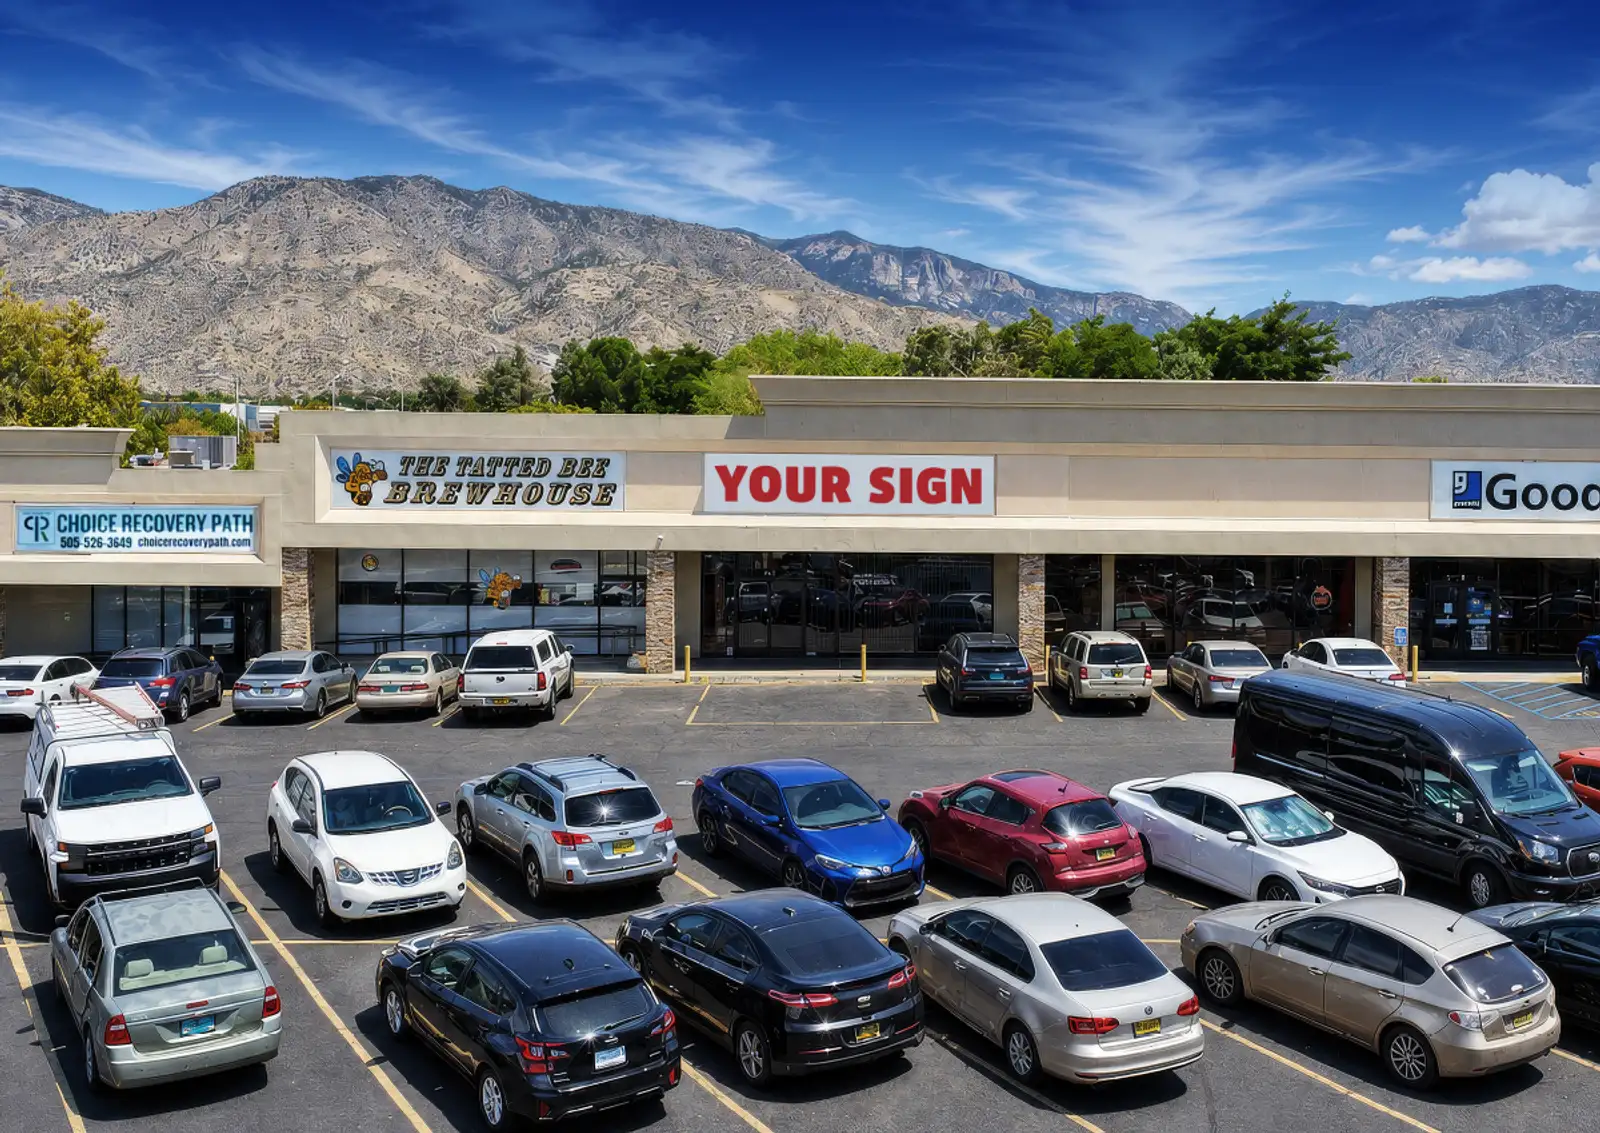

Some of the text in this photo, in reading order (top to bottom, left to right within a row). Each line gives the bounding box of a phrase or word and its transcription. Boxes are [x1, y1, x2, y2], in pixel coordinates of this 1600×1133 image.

[399, 456, 611, 478] THE TATTED BEE
[383, 481, 617, 506] BREWHOUSE
[714, 465, 982, 504] YOUR SIGN
[57, 514, 254, 533] CHOICE RECOVERY PATH
[60, 536, 251, 549] 505-526-3649 choicerecoverypath.com
